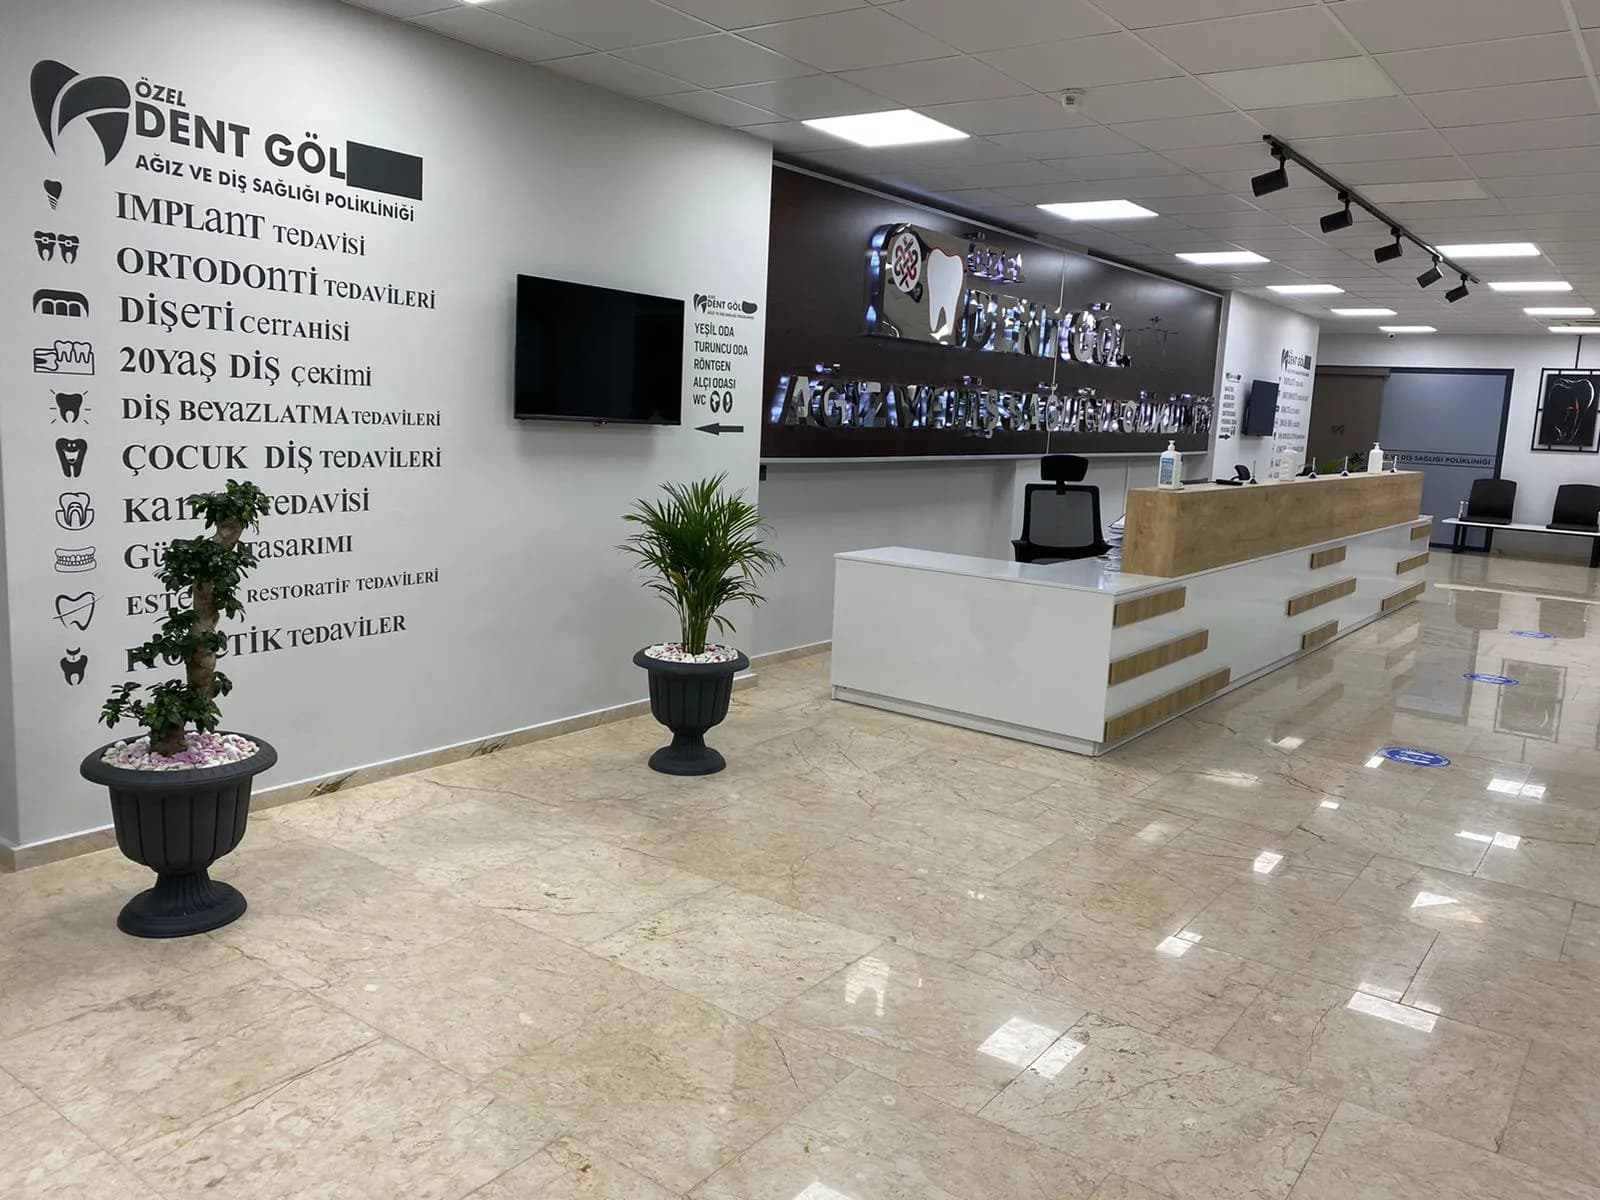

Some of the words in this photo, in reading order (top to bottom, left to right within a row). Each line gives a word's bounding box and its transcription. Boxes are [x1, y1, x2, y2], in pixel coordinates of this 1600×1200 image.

[135, 76, 186, 107] ÖZEL
[135, 100, 250, 158] DENT
[264, 131, 346, 180] GÖL
[135, 153, 183, 177] AĞIZ
[189, 164, 212, 183] VE
[219, 169, 247, 193] DİŞ
[253, 178, 320, 204] SAĞLIĞI
[325, 191, 415, 222] POLİKLİNİĞİ
[707, 299, 726, 309] DENT
[694, 321, 717, 337] YEŞİL
[718, 325, 735, 337] ODA
[694, 340, 732, 355] TURUNCU
[732, 345, 748, 356] ODA
[229, 350, 280, 386] DİŞ
[693, 358, 731, 371] RÖNTGEN
[693, 376, 711, 390] ALÇI
[712, 377, 736, 389] ODASI
[121, 393, 170, 425] DİŞ
[693, 394, 706, 405] WC
[122, 444, 249, 477] ÇOCUK
[264, 440, 313, 474] DİŞ
